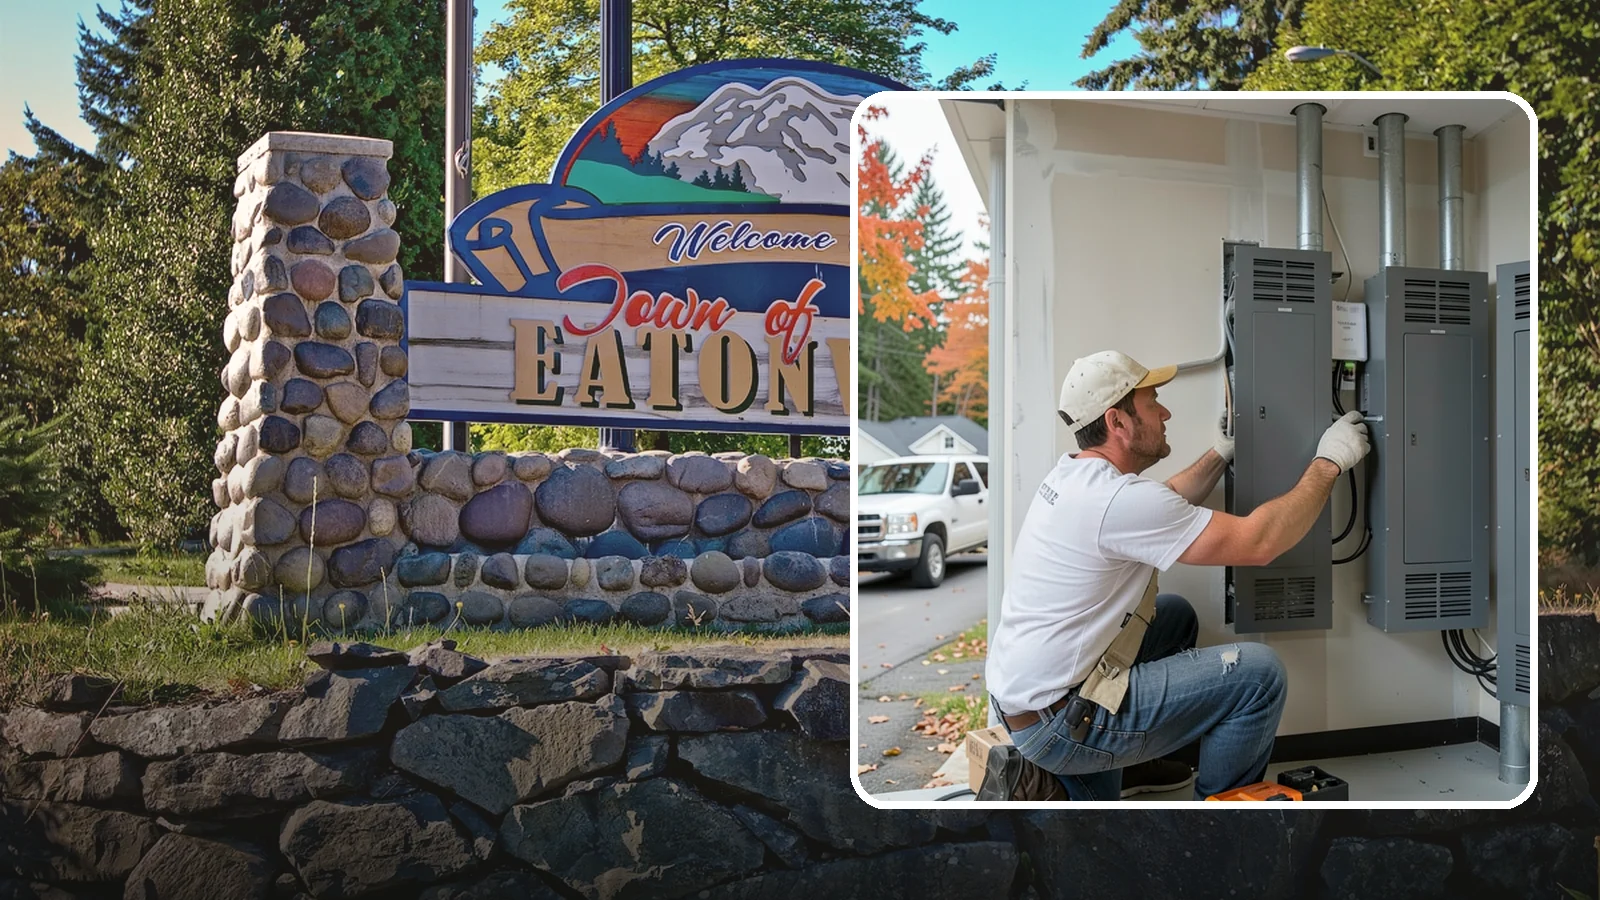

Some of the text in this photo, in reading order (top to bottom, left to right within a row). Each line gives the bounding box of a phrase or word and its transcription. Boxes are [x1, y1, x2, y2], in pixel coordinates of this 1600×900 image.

[653, 221, 837, 263] Welcome
[557, 263, 826, 365] Town of
